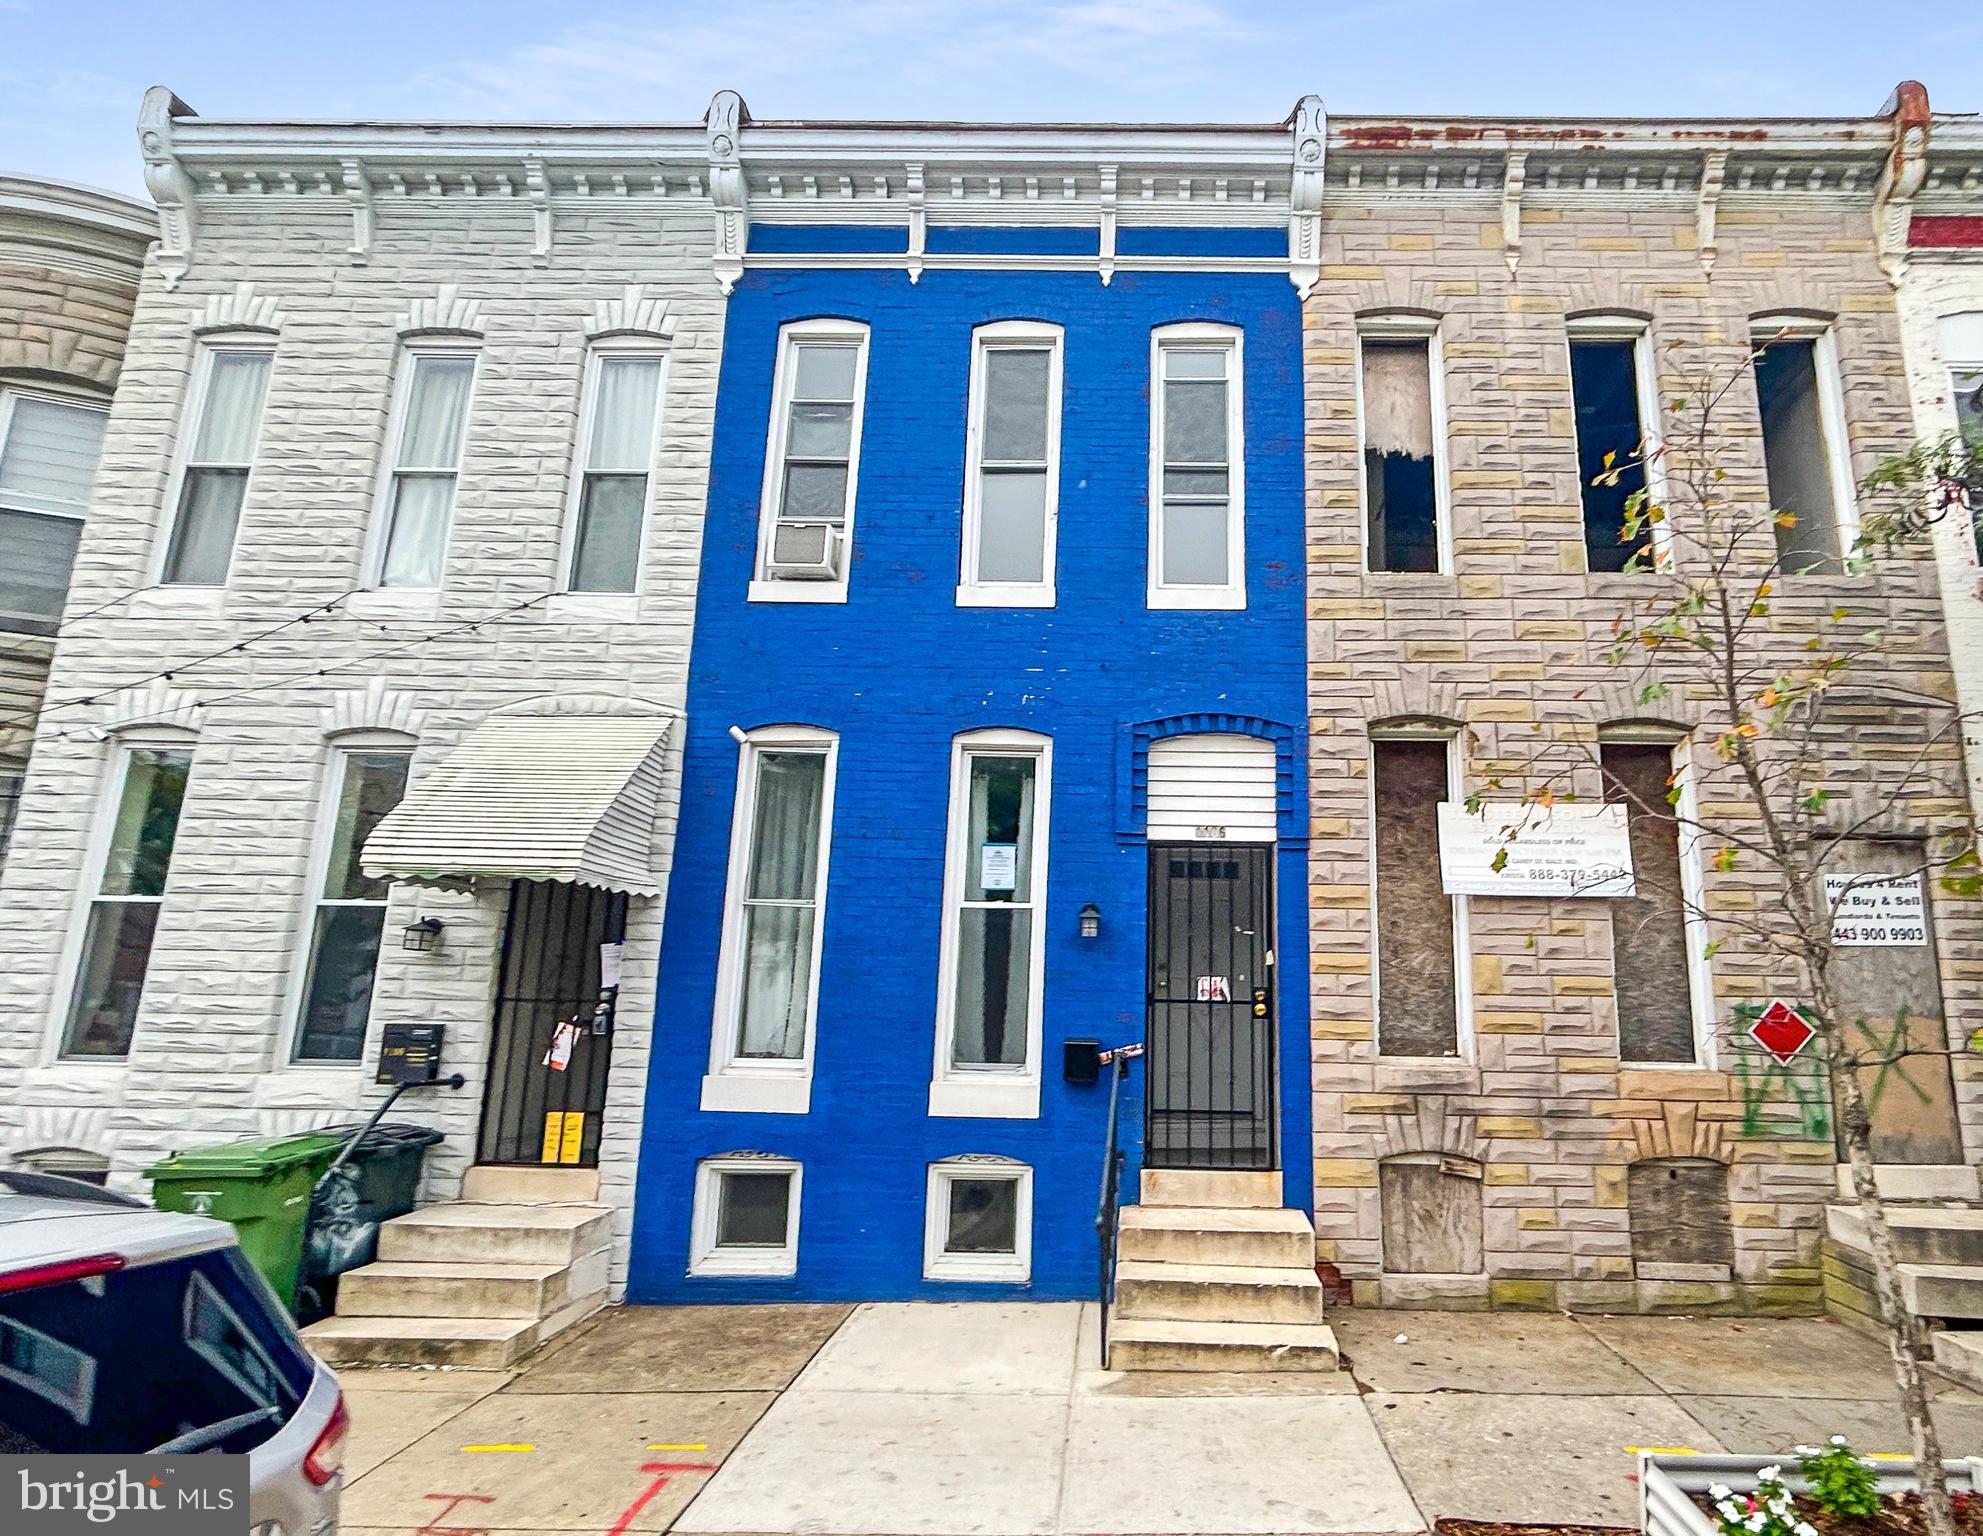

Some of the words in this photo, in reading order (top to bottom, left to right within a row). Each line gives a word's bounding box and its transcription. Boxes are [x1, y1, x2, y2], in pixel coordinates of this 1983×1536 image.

[1852, 896, 1876, 908] Buy
[1881, 896, 1890, 906] &
[1895, 896, 1920, 906] Sell
[1861, 928, 1886, 940] 900
[1890, 928, 1923, 940] 9903
